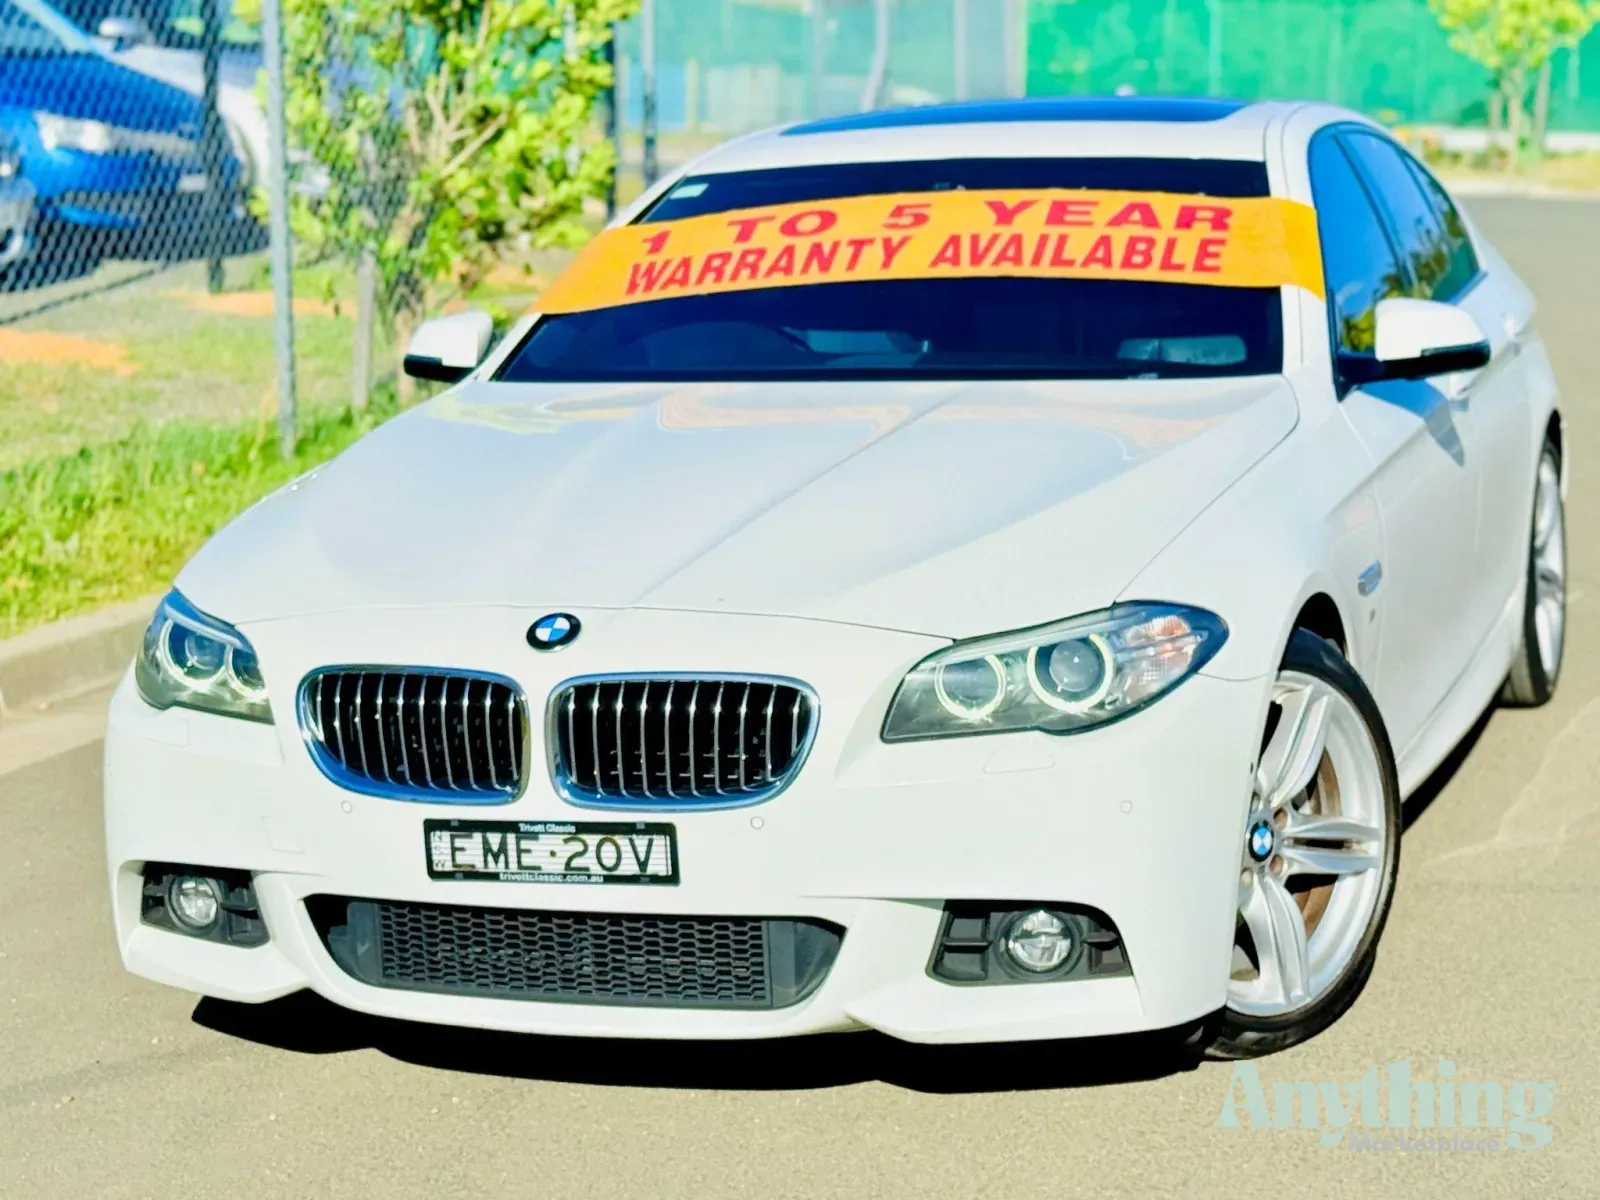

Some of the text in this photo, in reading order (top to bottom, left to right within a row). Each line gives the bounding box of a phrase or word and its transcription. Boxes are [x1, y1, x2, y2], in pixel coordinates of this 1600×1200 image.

[642, 200, 1234, 255] 1 TO 5 YEAR
[625, 232, 1228, 297] WARRANTY AVAILABLE
[546, 822, 576, 833] Classic
[500, 871, 604, 883] trivettclassic.com.au
